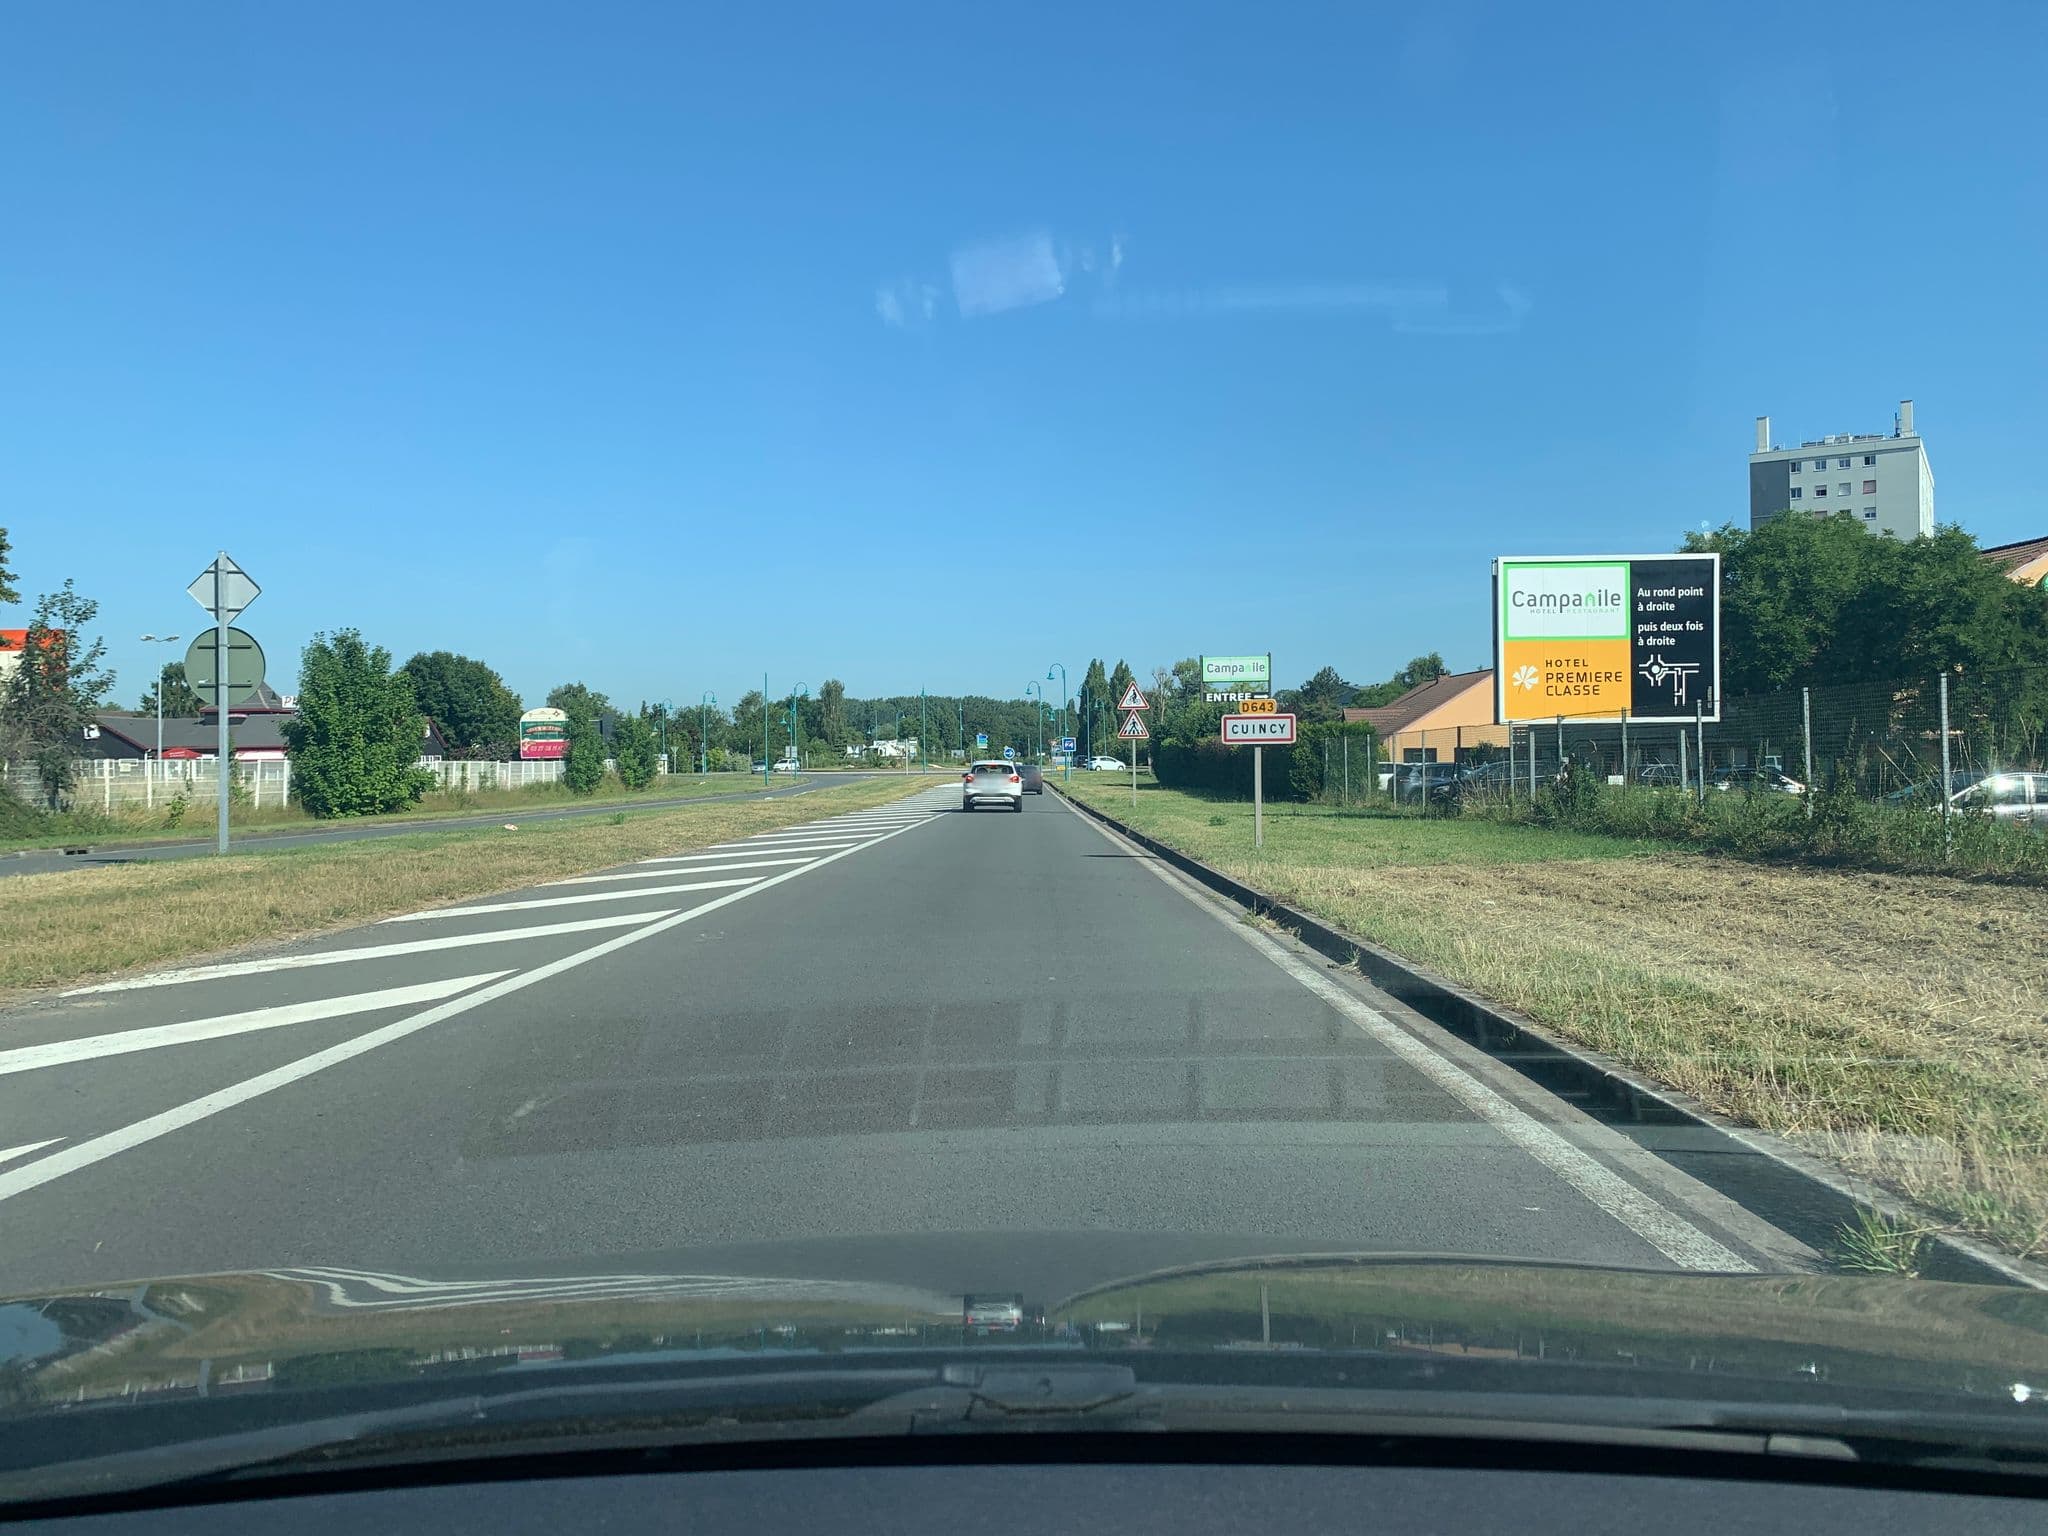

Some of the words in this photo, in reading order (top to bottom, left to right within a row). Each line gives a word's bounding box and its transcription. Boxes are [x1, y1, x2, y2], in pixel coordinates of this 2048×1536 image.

[1637, 588, 1650, 597] Au
[1653, 587, 1675, 597] rond
[1678, 586, 1704, 599] point
[1512, 589, 1621, 613] Campanile
[1637, 602, 1644, 611] à
[1646, 601, 1675, 611] droite
[1637, 622, 1658, 634] puis
[1660, 621, 1684, 631] deux
[1685, 621, 1704, 631] fois
[1637, 636, 1644, 646] à
[1646, 636, 1675, 646] droite
[1207, 662, 1265, 675] Campanile
[1545, 659, 1588, 668] HOTEL
[1546, 672, 1623, 683] PREMIERE
[1546, 685, 1601, 697] CLASSE
[1206, 692, 1252, 702] ENTREE
[1242, 702, 1274, 712] D643
[1231, 723, 1286, 735] CUINCY
